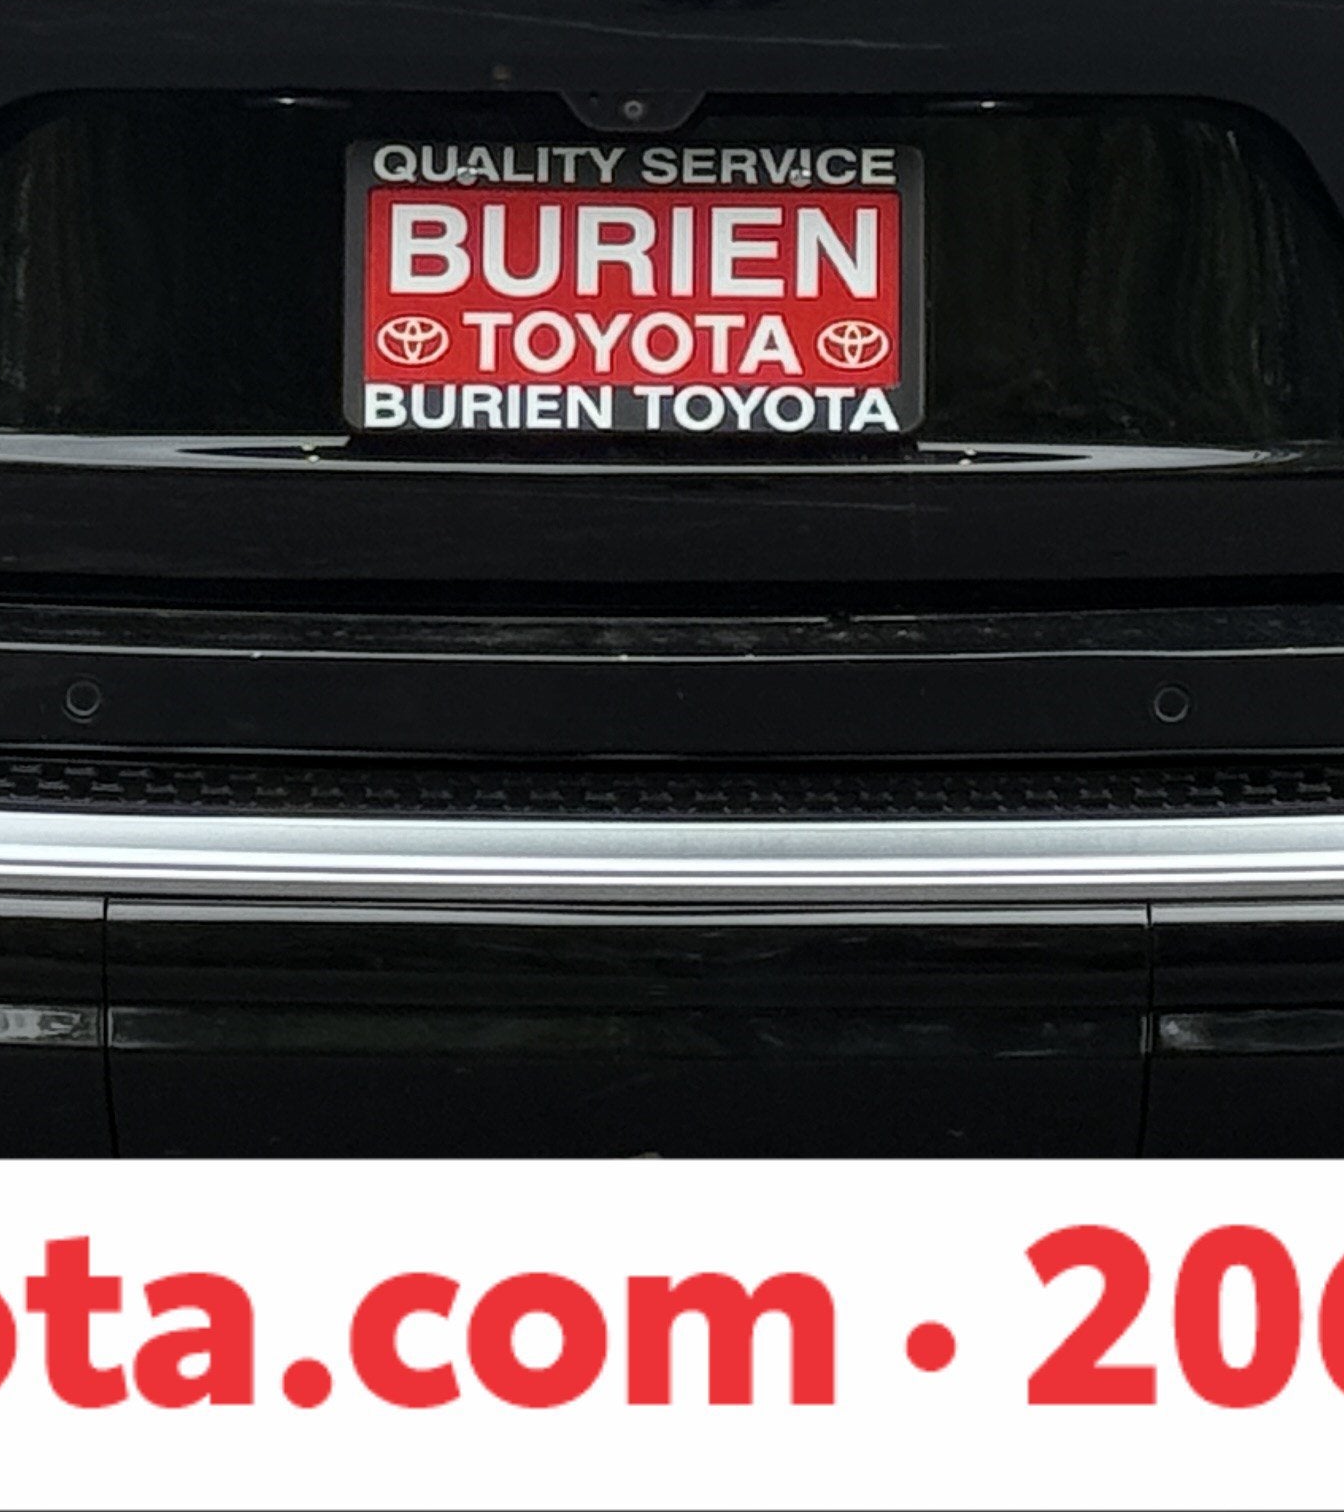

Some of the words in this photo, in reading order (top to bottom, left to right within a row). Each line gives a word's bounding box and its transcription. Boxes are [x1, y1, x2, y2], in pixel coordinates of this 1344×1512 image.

[373, 144, 625, 185] QUALITY
[641, 147, 897, 185] SERVICE
[389, 204, 878, 299] BURIEN
[462, 310, 804, 376] TOYOTA
[363, 383, 613, 430] BURIEN
[633, 385, 900, 432] TOYOTA
